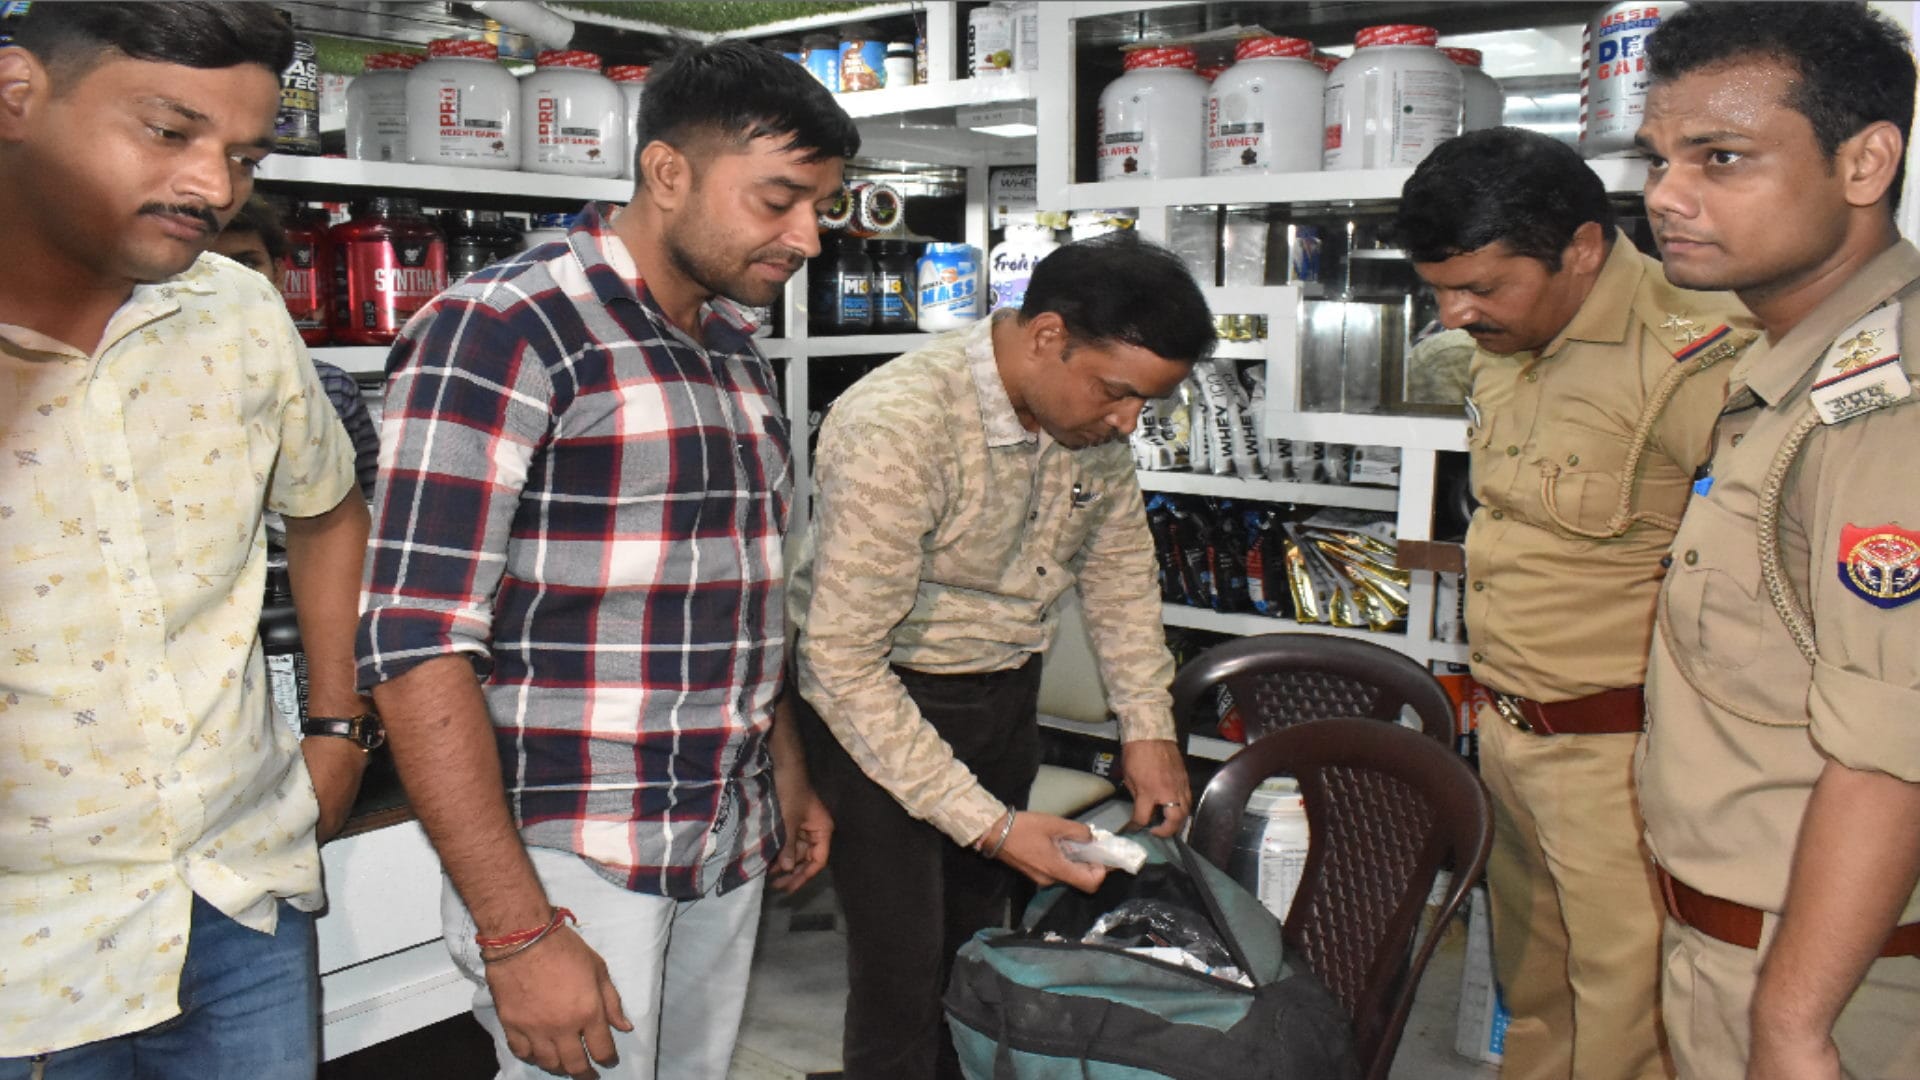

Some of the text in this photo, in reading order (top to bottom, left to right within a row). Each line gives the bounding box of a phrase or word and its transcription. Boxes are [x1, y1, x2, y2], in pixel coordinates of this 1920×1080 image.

[1600, 7, 1660, 28] USSR
[1597, 57, 1645, 80] GAI
[282, 74, 317, 91] TEC
[440, 88, 456, 127] PRO
[538, 98, 553, 135] PRO
[1226, 137, 1259, 147] WHEY
[1002, 177, 1036, 189] WHE
[921, 278, 975, 305] MASS
[1215, 404, 1233, 457] WHEY
[1236, 402, 1258, 456] WHEY
